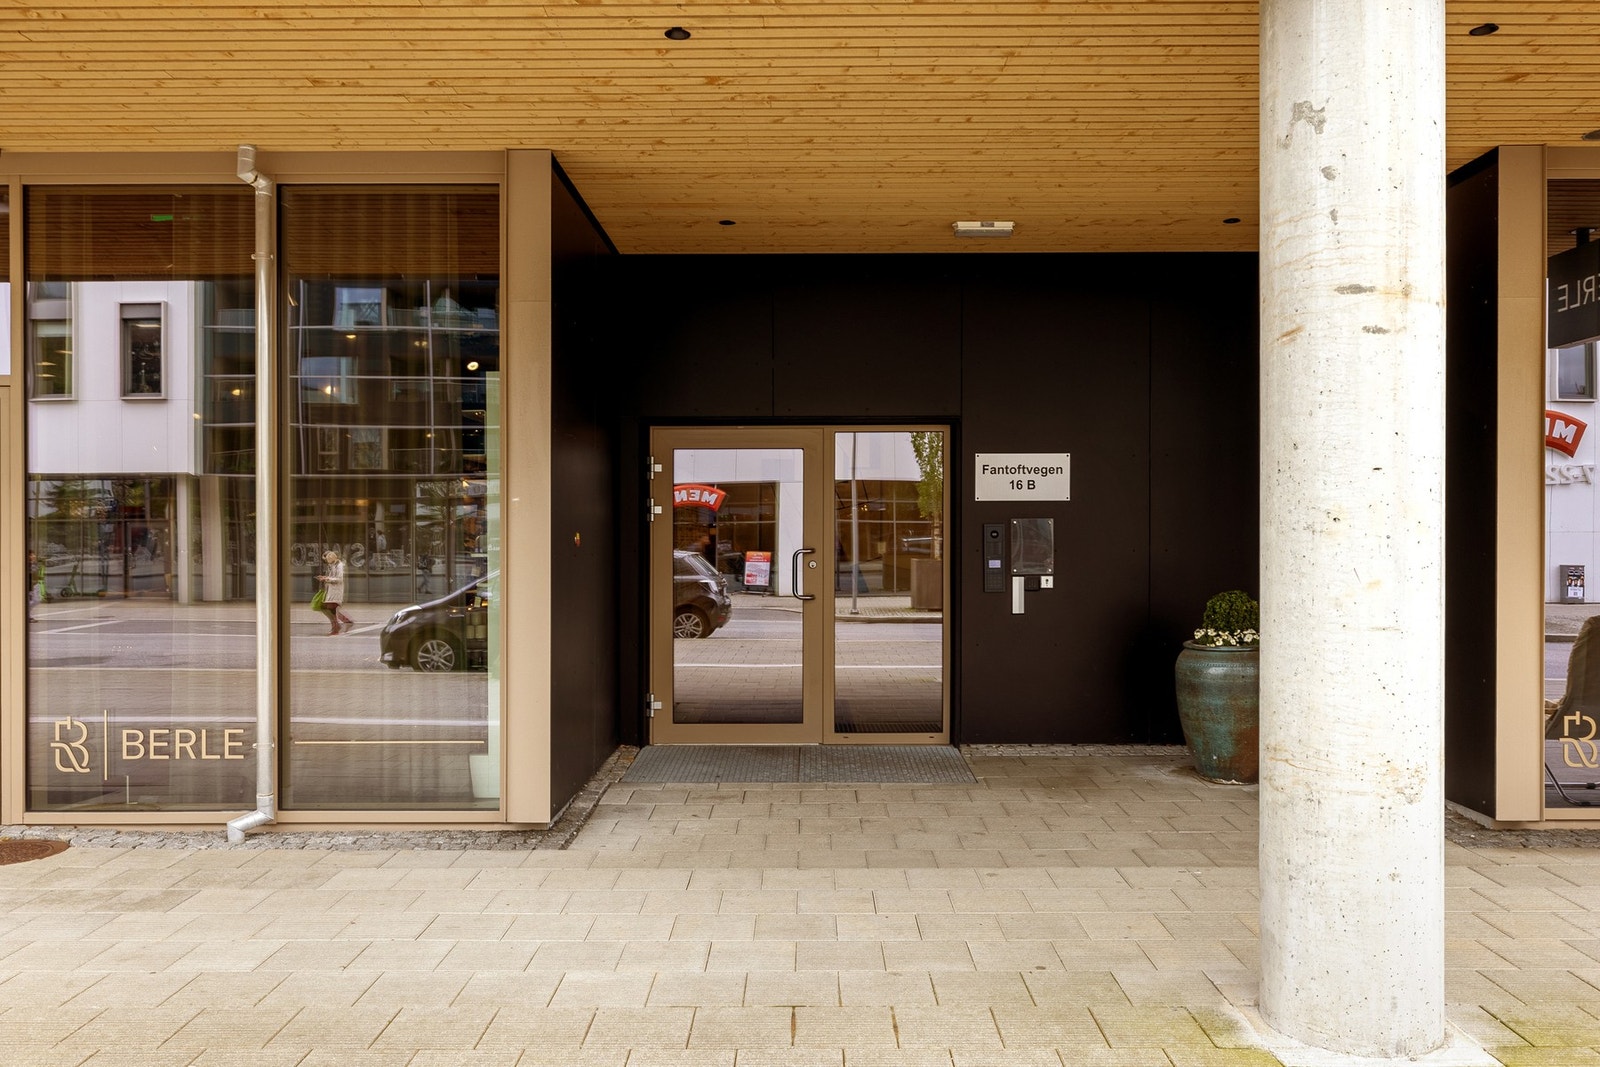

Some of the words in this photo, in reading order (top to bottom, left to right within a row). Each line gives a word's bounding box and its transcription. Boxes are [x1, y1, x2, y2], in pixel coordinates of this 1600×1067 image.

[982, 464, 1063, 477] Fantoftvegen
[1009, 480, 1023, 490] 16
[1027, 480, 1036, 490] B
[122, 729, 245, 760] BERLE
